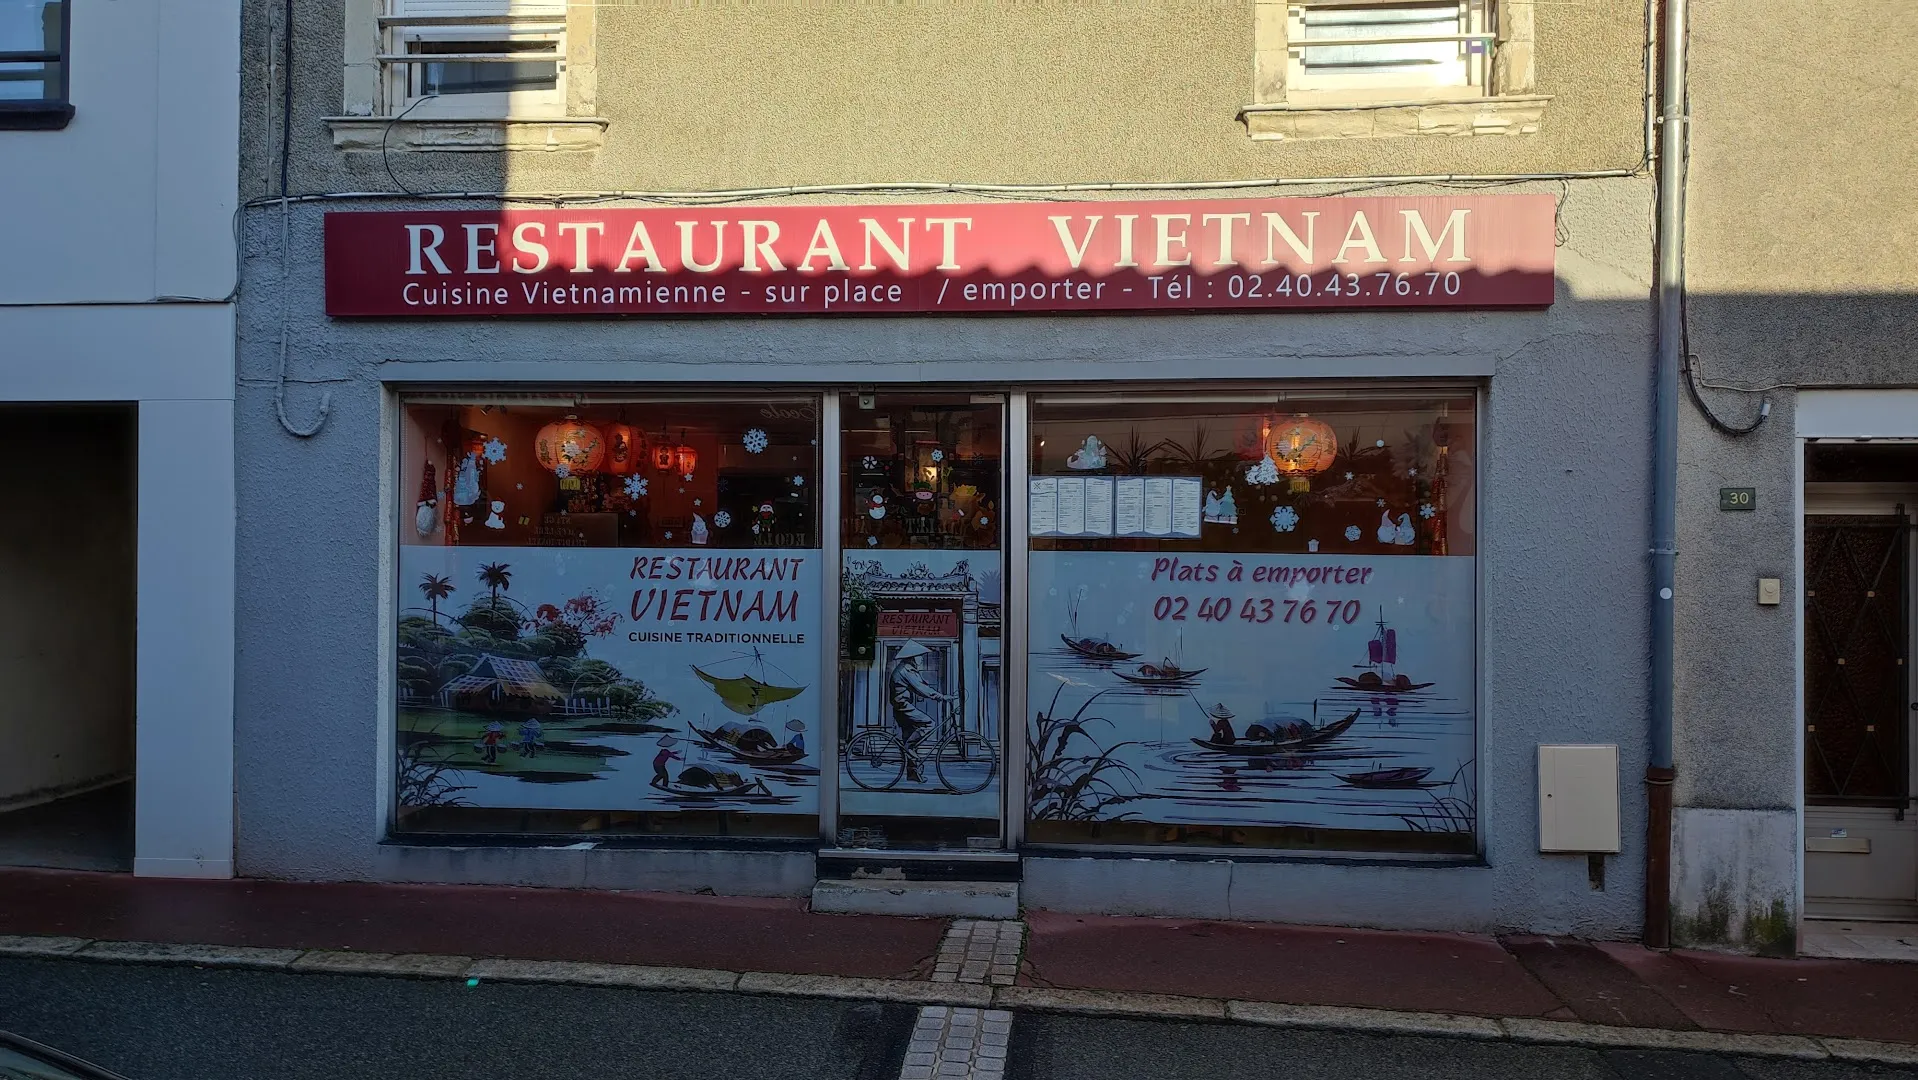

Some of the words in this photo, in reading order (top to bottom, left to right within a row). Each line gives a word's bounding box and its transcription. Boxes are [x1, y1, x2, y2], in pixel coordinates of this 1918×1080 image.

[403, 216, 973, 275] RESTAURANT
[1047, 208, 1472, 268] VIETNAM
[402, 281, 508, 306] Cuisine
[521, 279, 726, 305] Vietnamienne
[765, 285, 809, 303] sur
[824, 278, 903, 309] place
[936, 278, 951, 305] /
[963, 278, 1106, 307] emporter
[1148, 274, 1192, 300] Tél
[1228, 270, 1462, 299] 02.40.43.76.70
[1730, 492, 1750, 505] 30
[629, 556, 805, 581] RESTAURANT
[1151, 558, 1219, 582] Plats
[1227, 561, 1244, 581] à
[1252, 566, 1373, 586] emporter
[630, 589, 799, 622] VIETNAM
[881, 614, 951, 625] RESTAURANT
[1154, 597, 1187, 621] 02
[1197, 597, 1232, 621] 40
[1239, 597, 1274, 623] 43
[1283, 599, 1316, 624] 76
[1326, 599, 1361, 625] 70
[628, 632, 682, 643] CUISINE
[686, 633, 806, 645] TRADITIONNELLE
